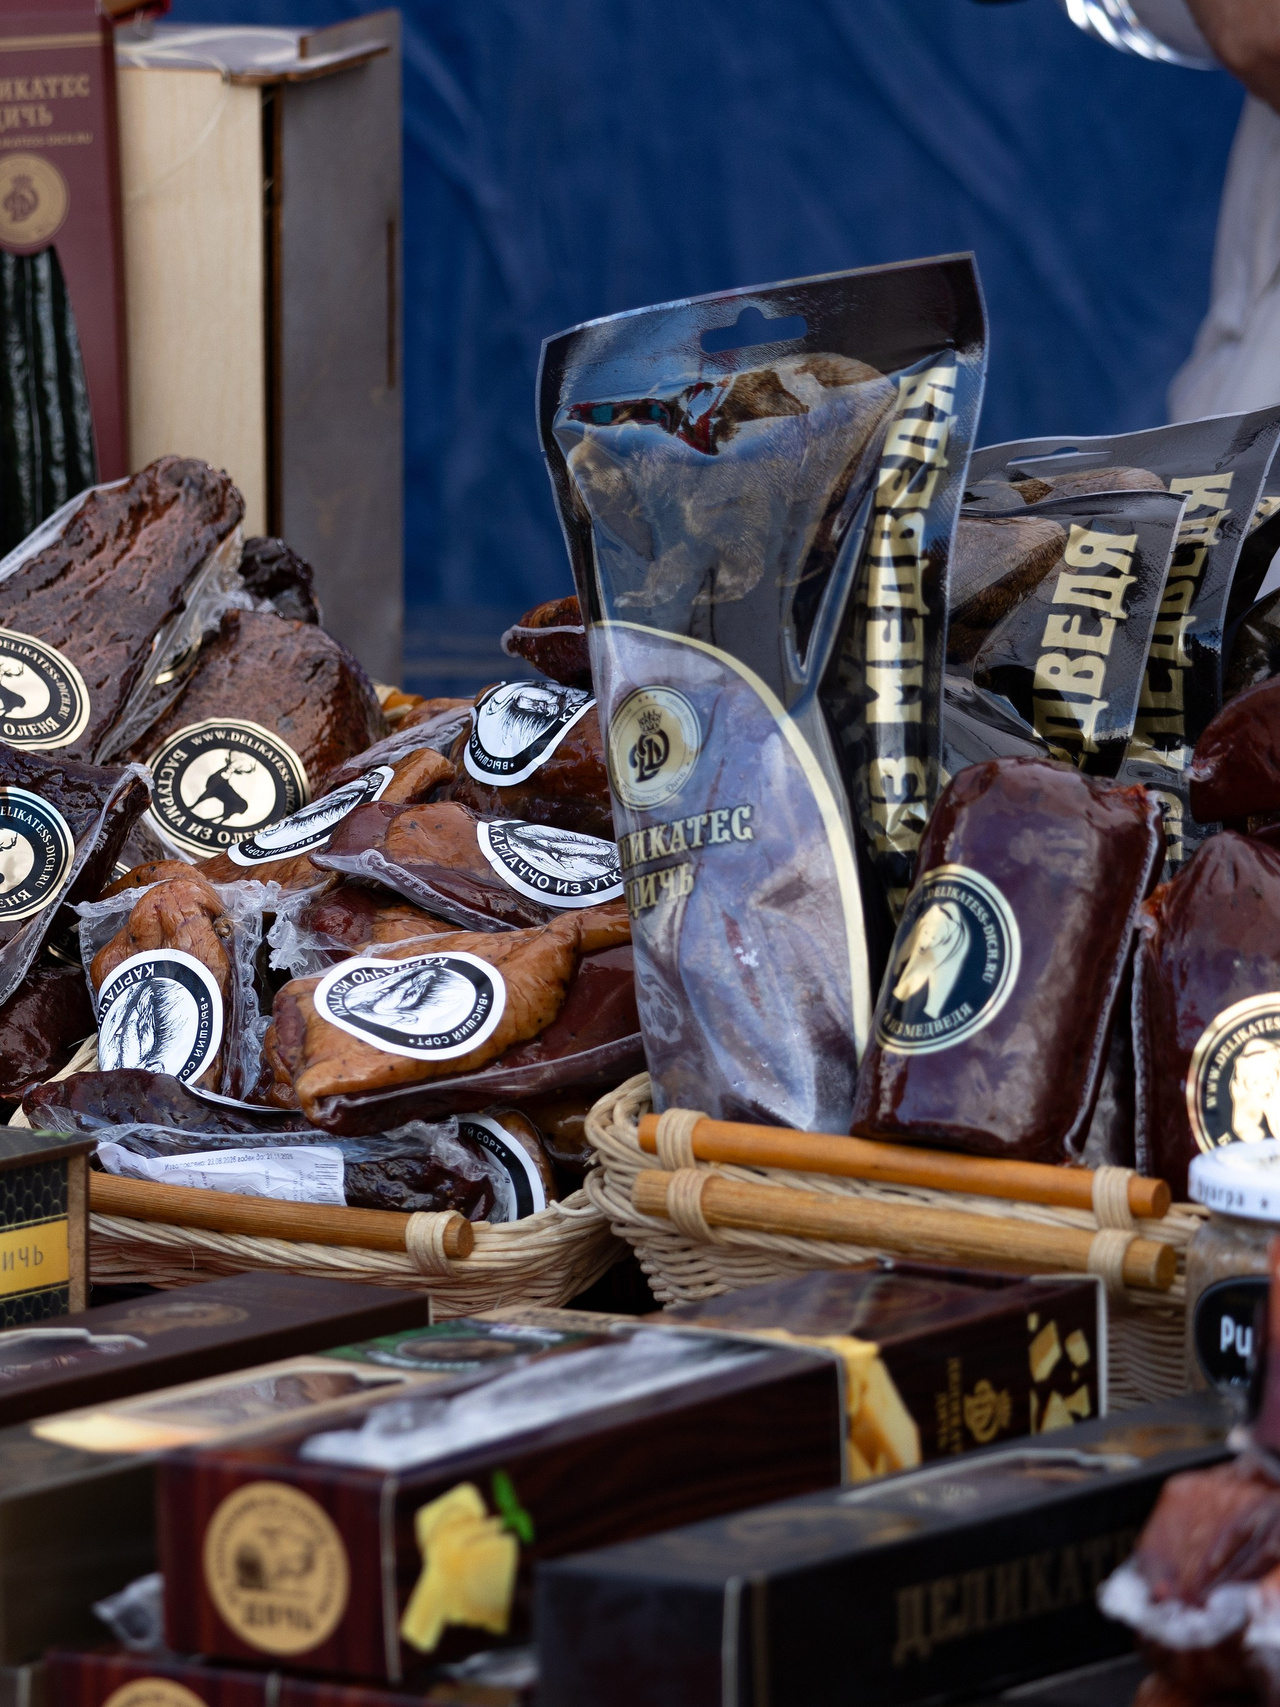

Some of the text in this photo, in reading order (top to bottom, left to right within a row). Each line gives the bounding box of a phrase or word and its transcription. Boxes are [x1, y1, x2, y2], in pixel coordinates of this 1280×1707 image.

[866, 365, 959, 855] ИЗ МЕДВЕДЯ
[3, 716, 62, 737] ОЛЕНЯ
[474, 748, 509, 770] ВЫСШИЙ
[157, 748, 189, 828] БАСТУРМА
[186, 821, 214, 841] ИЗ
[489, 826, 623, 895] КАРПАЧЧО ИЗ УТК
[332, 978, 350, 995] ИЗ
[327, 995, 351, 1018] УТКИ
[415, 997, 489, 1047] ВЫСШИЙ СОРТ
[903, 1001, 974, 1038] МЕДВЕДЯ
[193, 1002, 210, 1058] ВЫСШИЙ
[476, 1132, 503, 1154] СОРТ
